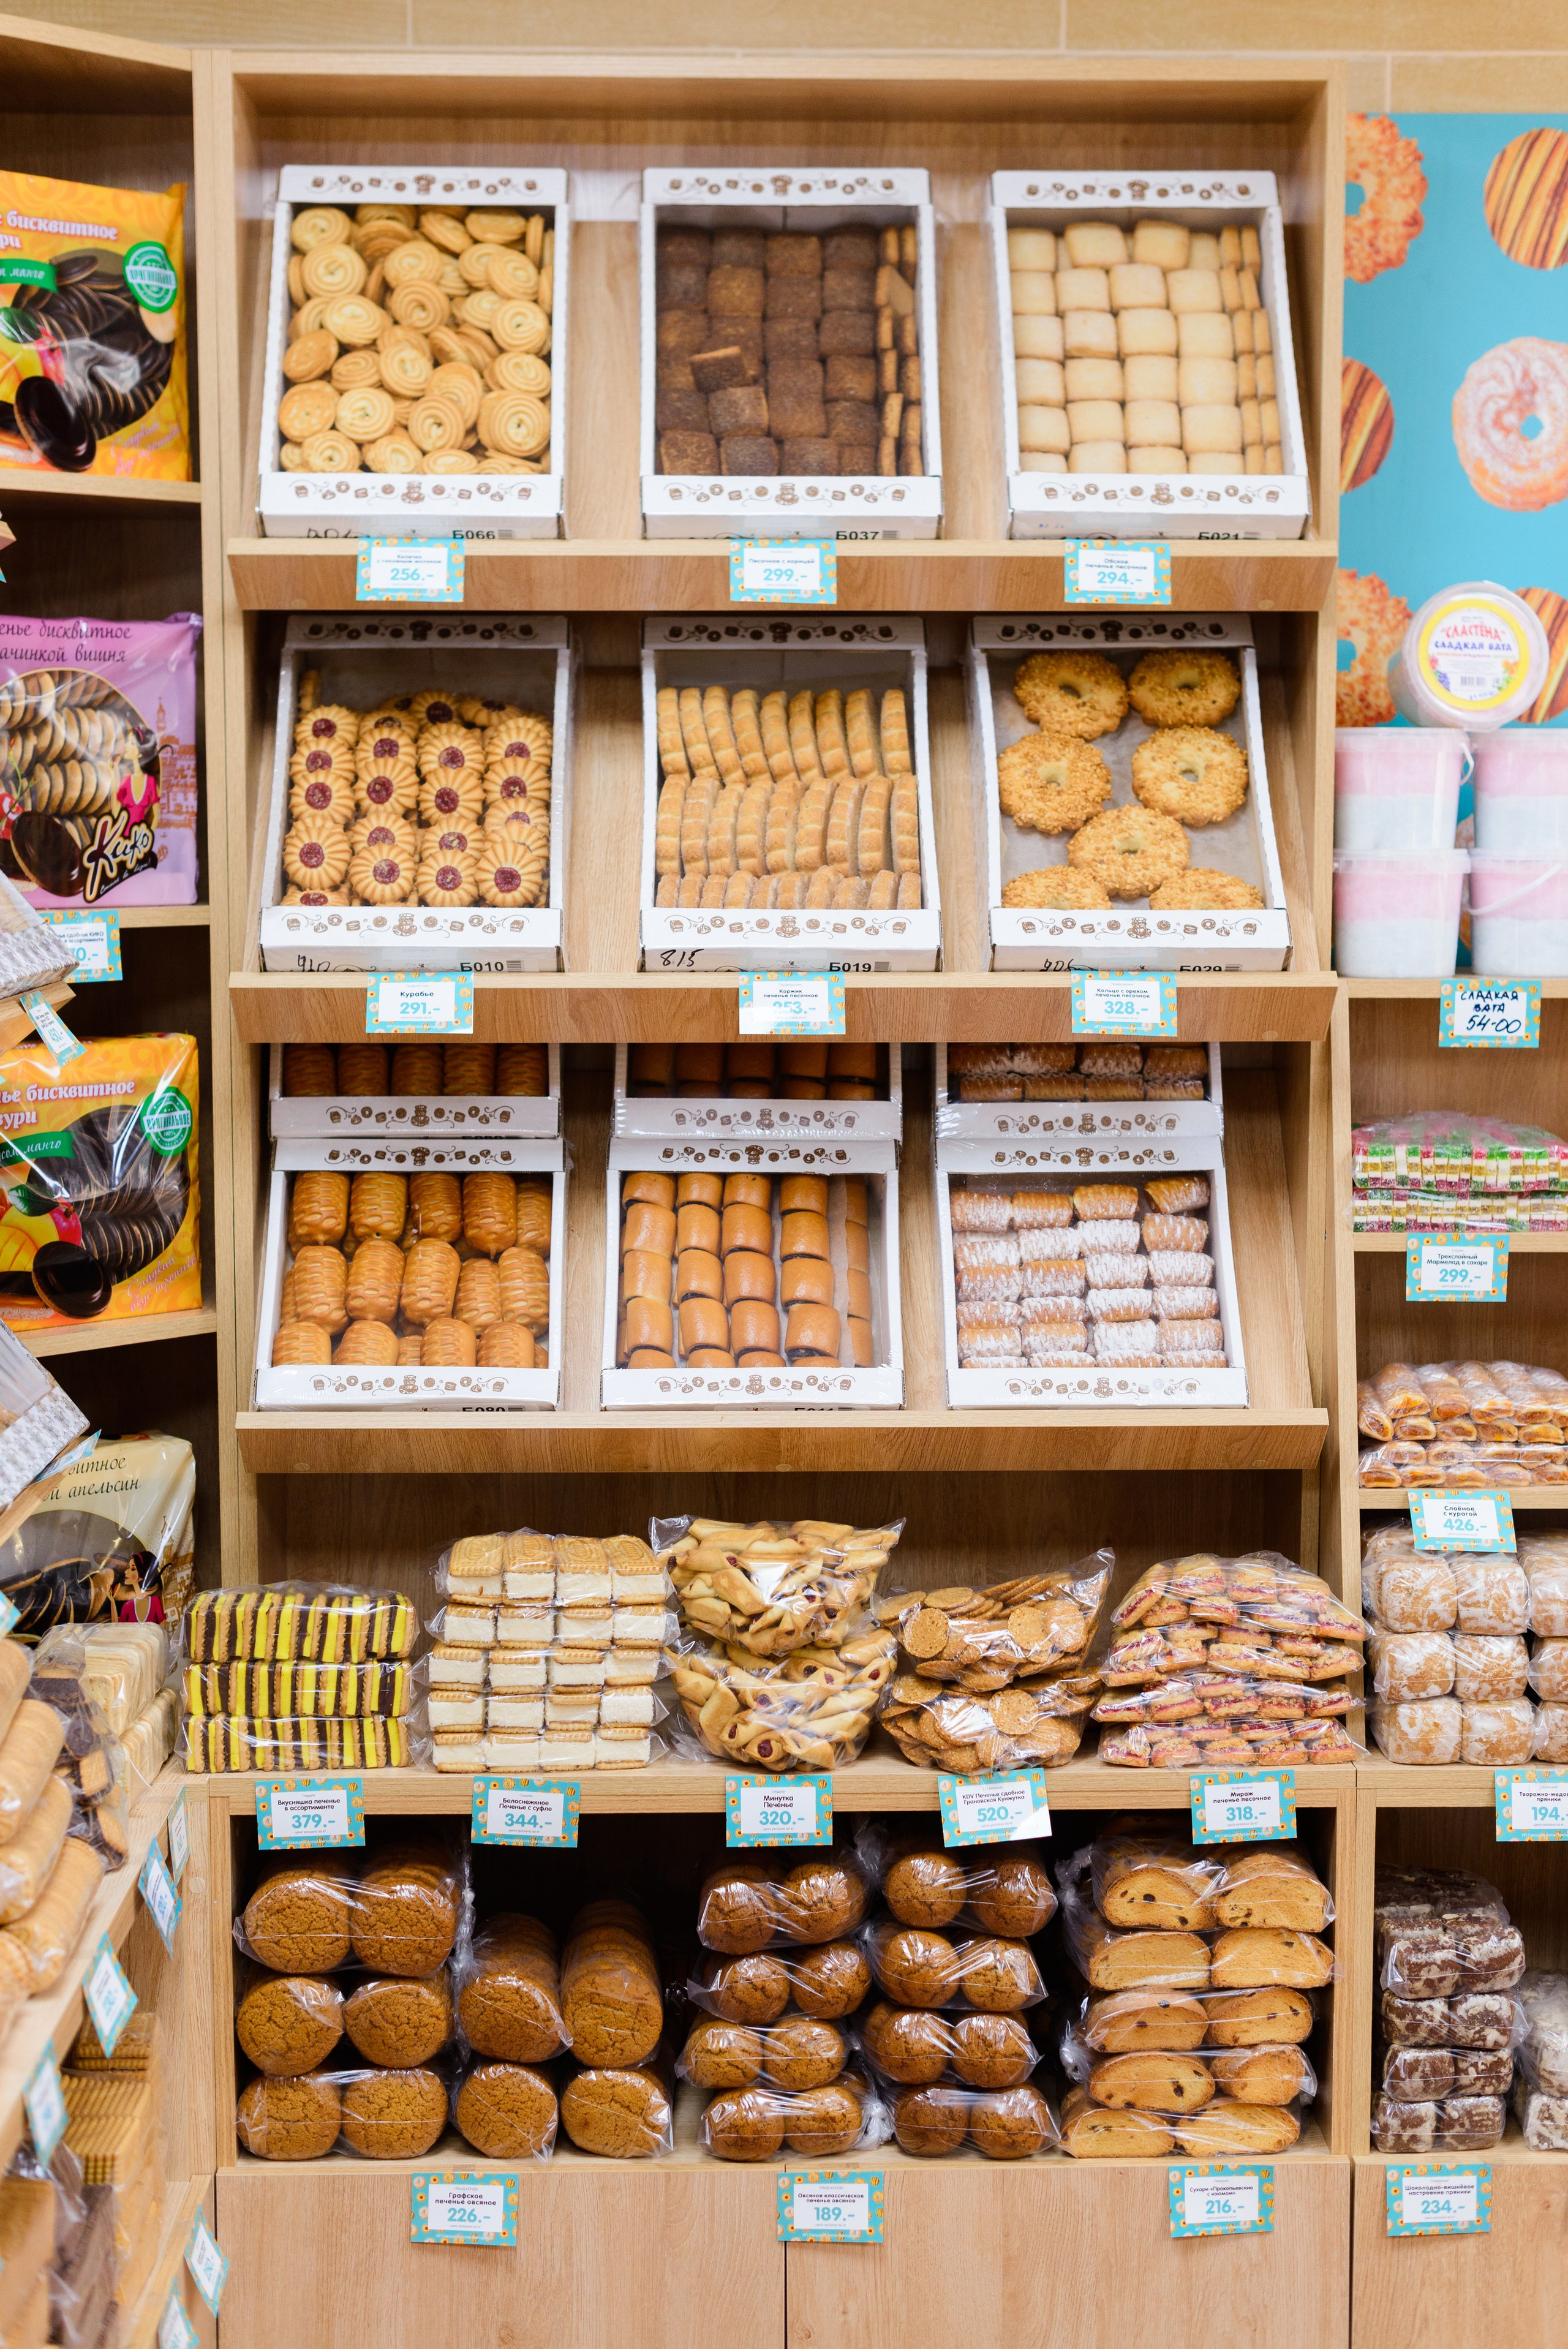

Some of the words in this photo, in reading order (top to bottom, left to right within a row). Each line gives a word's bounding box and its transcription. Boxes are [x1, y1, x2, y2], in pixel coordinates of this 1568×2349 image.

[7, 209, 118, 240] бисквитное
[836, 531, 880, 540] Б037
[0, 623, 32, 636] енье
[39, 620, 132, 638] бисквитное
[1434, 641, 1484, 650] СЛАДКАЯ
[0, 646, 67, 661] ачинкой
[75, 644, 126, 662] вишня
[660, 949, 704, 967] 815
[460, 962, 504, 972] Б010
[829, 962, 872, 972] Б019
[1461, 990, 1518, 1002] СЛАДКАЯ
[1473, 1003, 1505, 1013] ВАТА
[1466, 1014, 1521, 1033] 54-00
[26, 1081, 135, 1101] бисквитное
[24, 1140, 61, 1153] манго
[69, 1479, 140, 1498] апельсин
[1531, 1807, 1568, 1820] 194.
